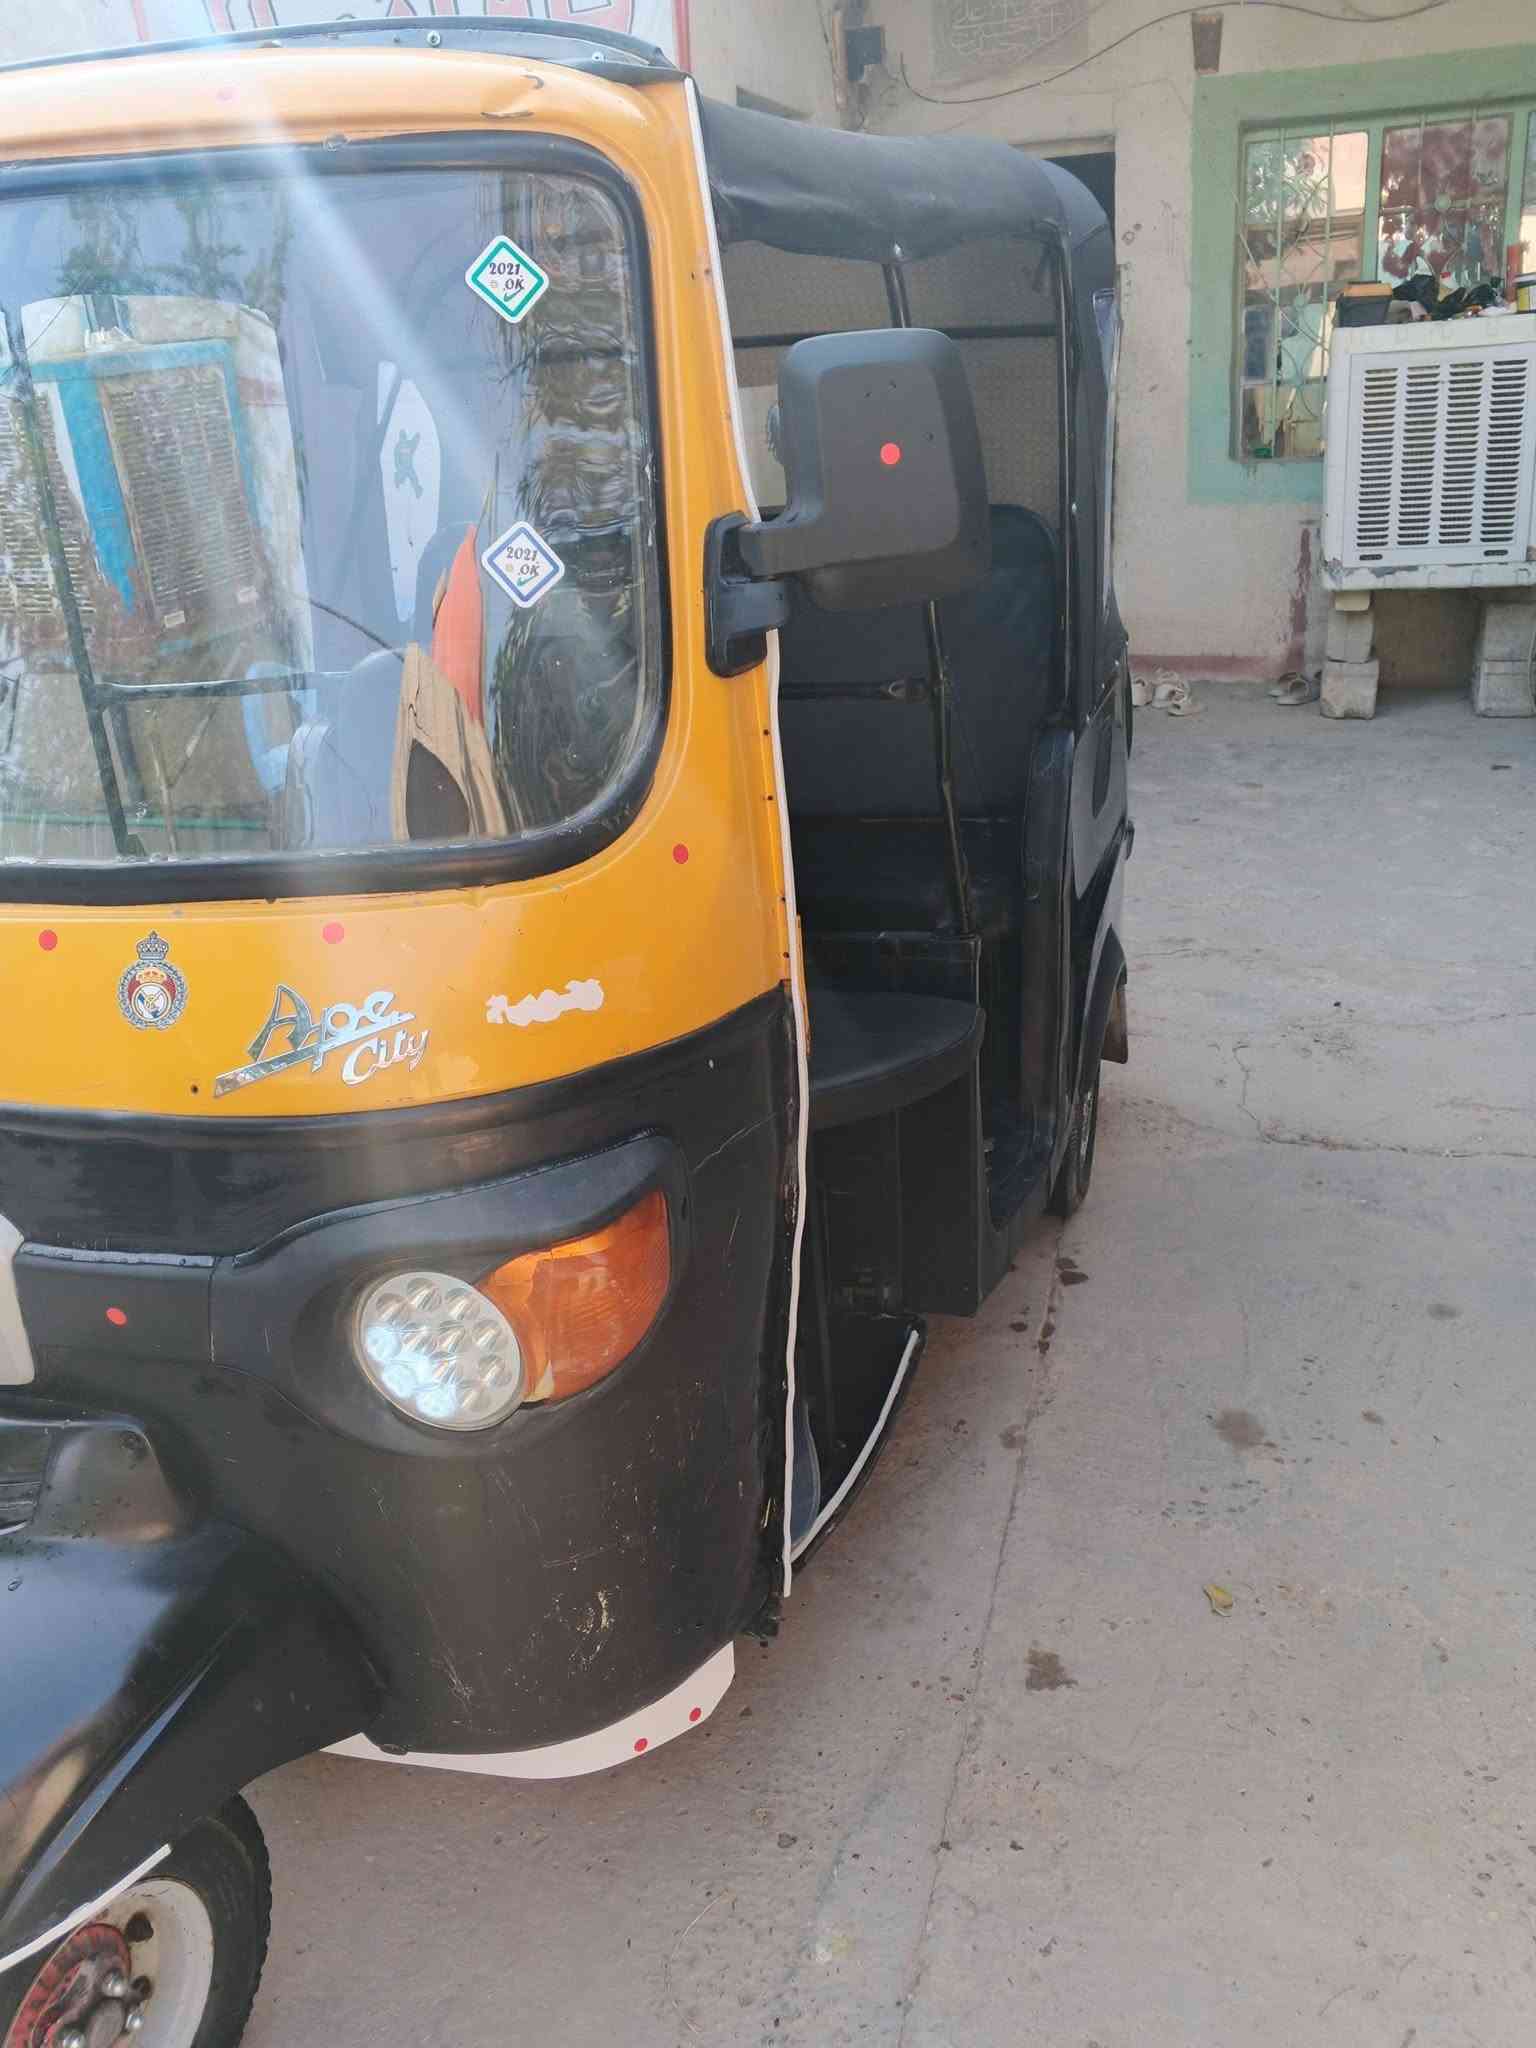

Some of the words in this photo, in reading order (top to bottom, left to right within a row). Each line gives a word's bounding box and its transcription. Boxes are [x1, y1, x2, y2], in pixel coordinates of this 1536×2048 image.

[489, 262, 521, 276] 2021
[504, 278, 525, 291] OK
[506, 546, 538, 562] 2021
[247, 983, 408, 1072] Ape
[342, 1029, 430, 1087] City
